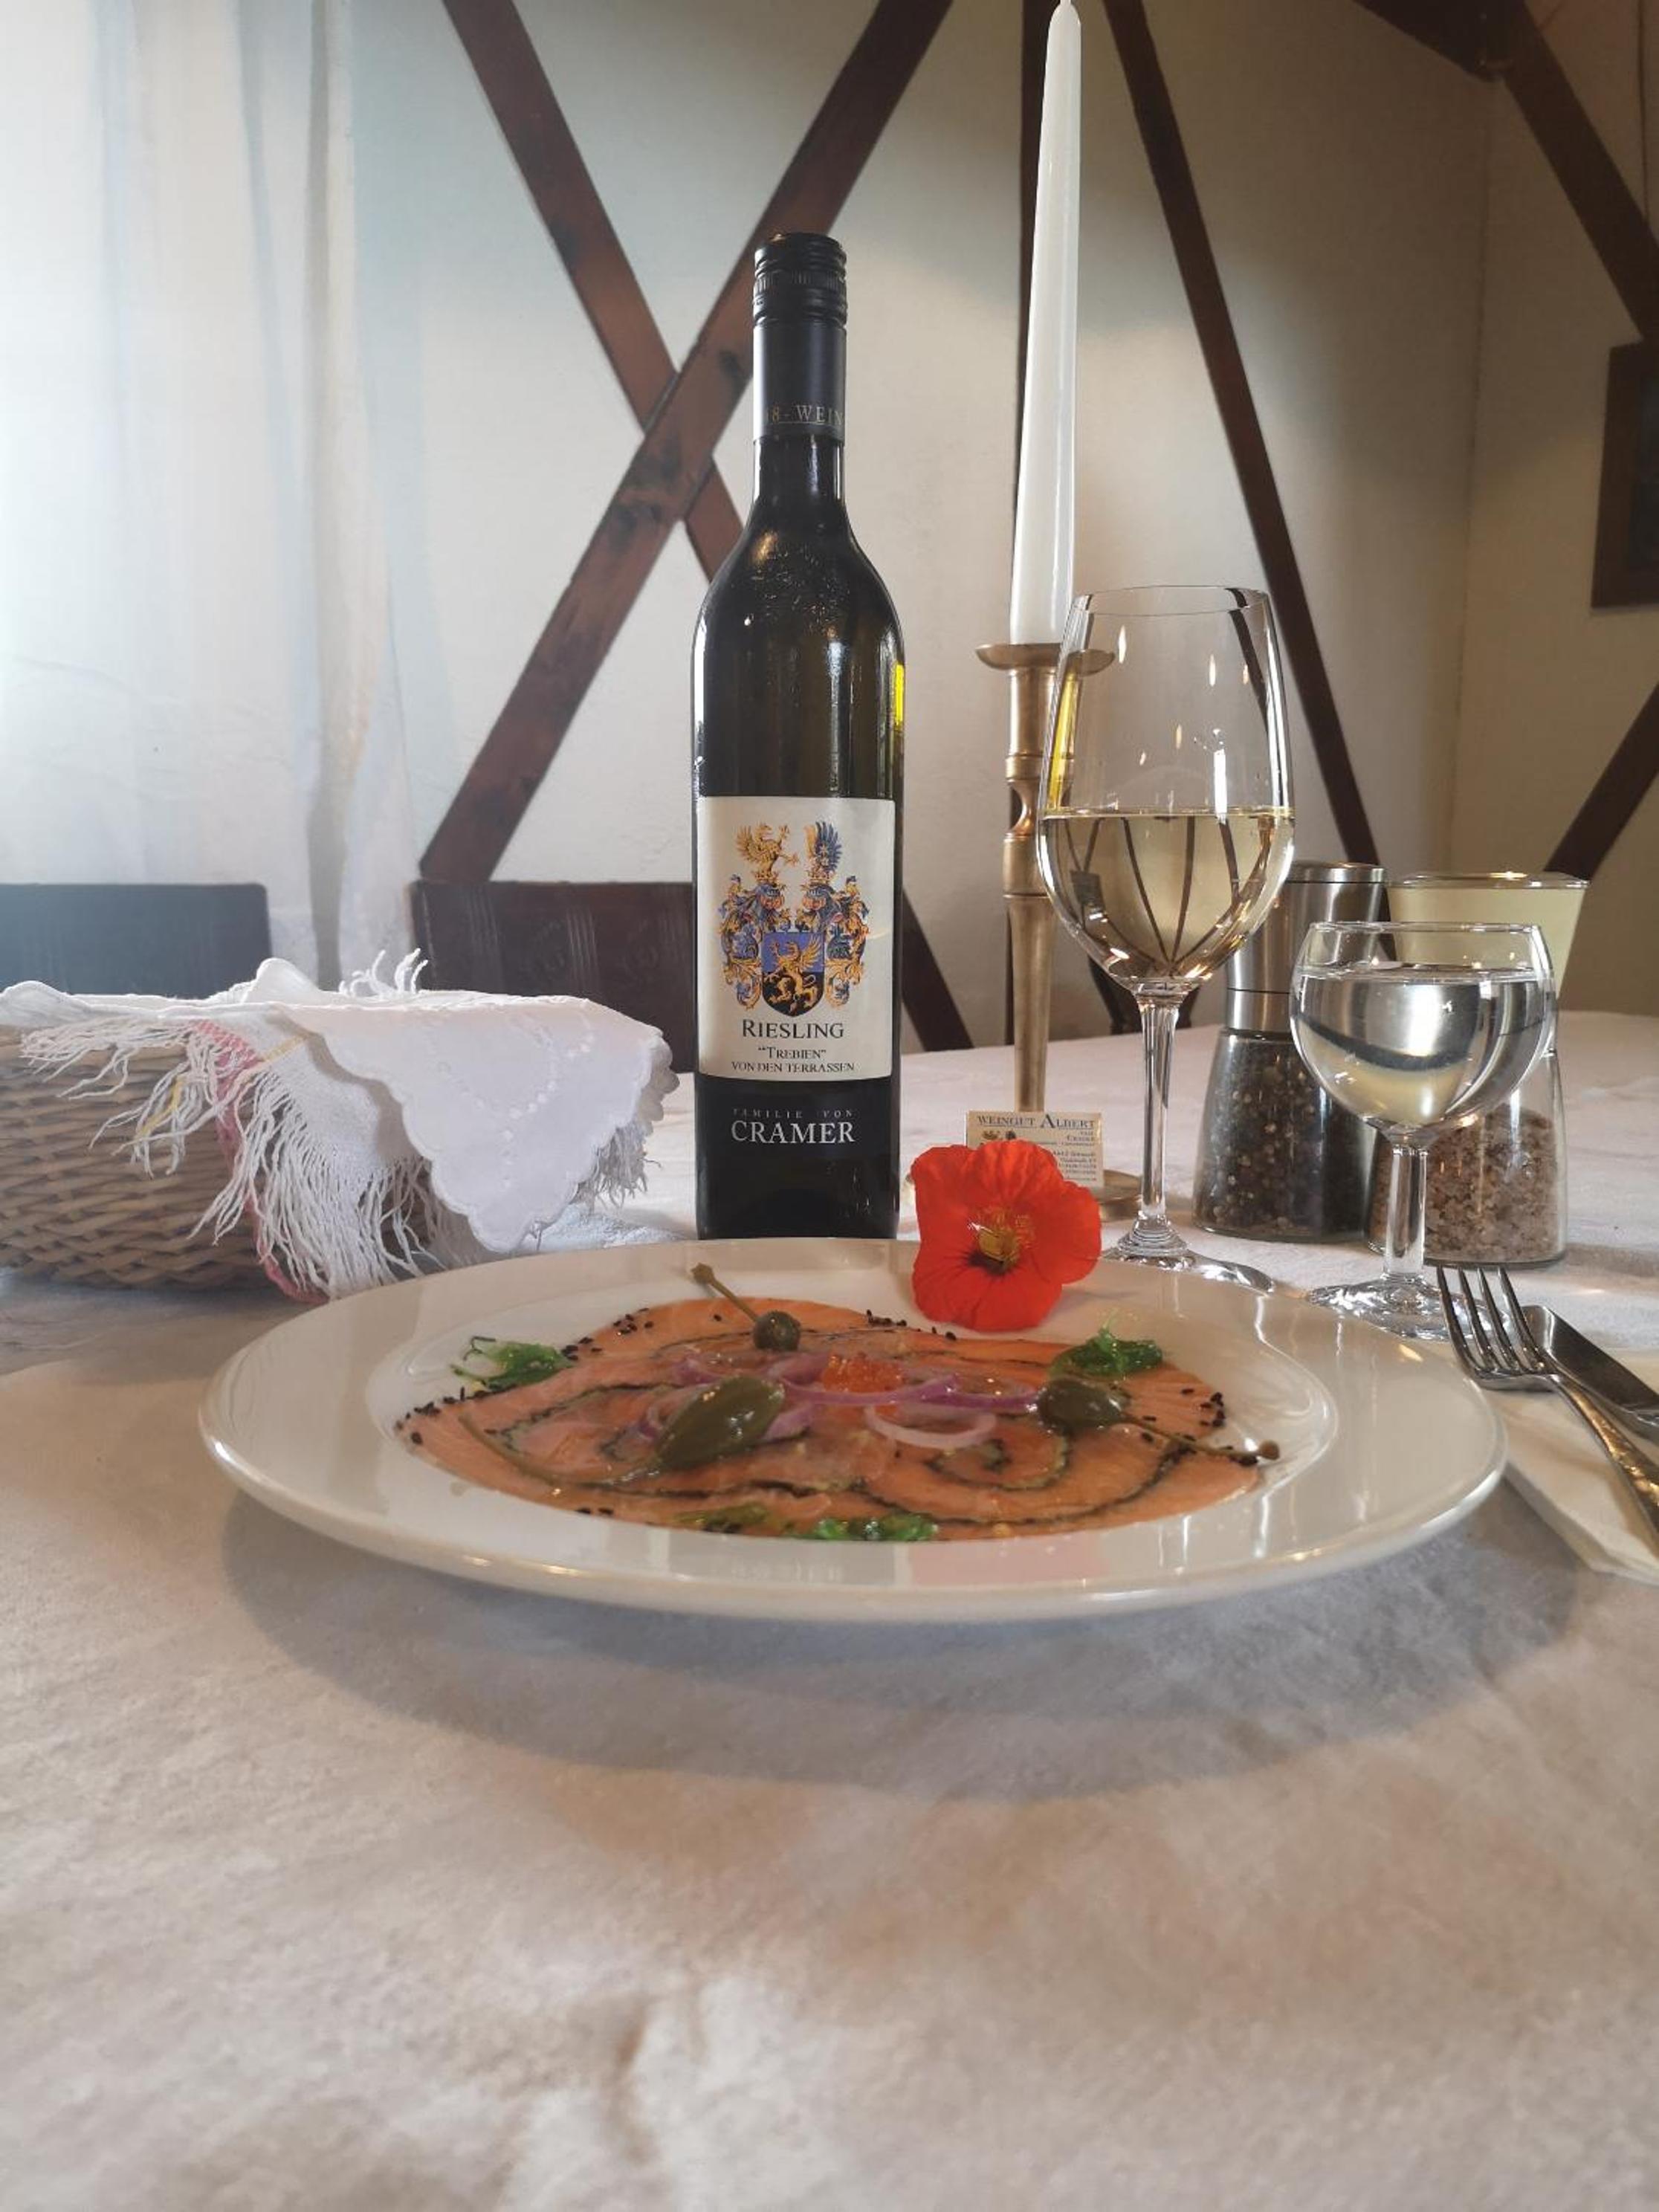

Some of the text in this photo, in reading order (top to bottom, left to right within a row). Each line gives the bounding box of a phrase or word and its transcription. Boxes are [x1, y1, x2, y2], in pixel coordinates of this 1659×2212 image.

[742, 1019, 844, 1039] RIESLING
[731, 1061, 855, 1073] VON DEN TERRASSEN
[978, 1115, 1036, 1126] WEINGUT
[731, 1120, 856, 1144] CRAMER
